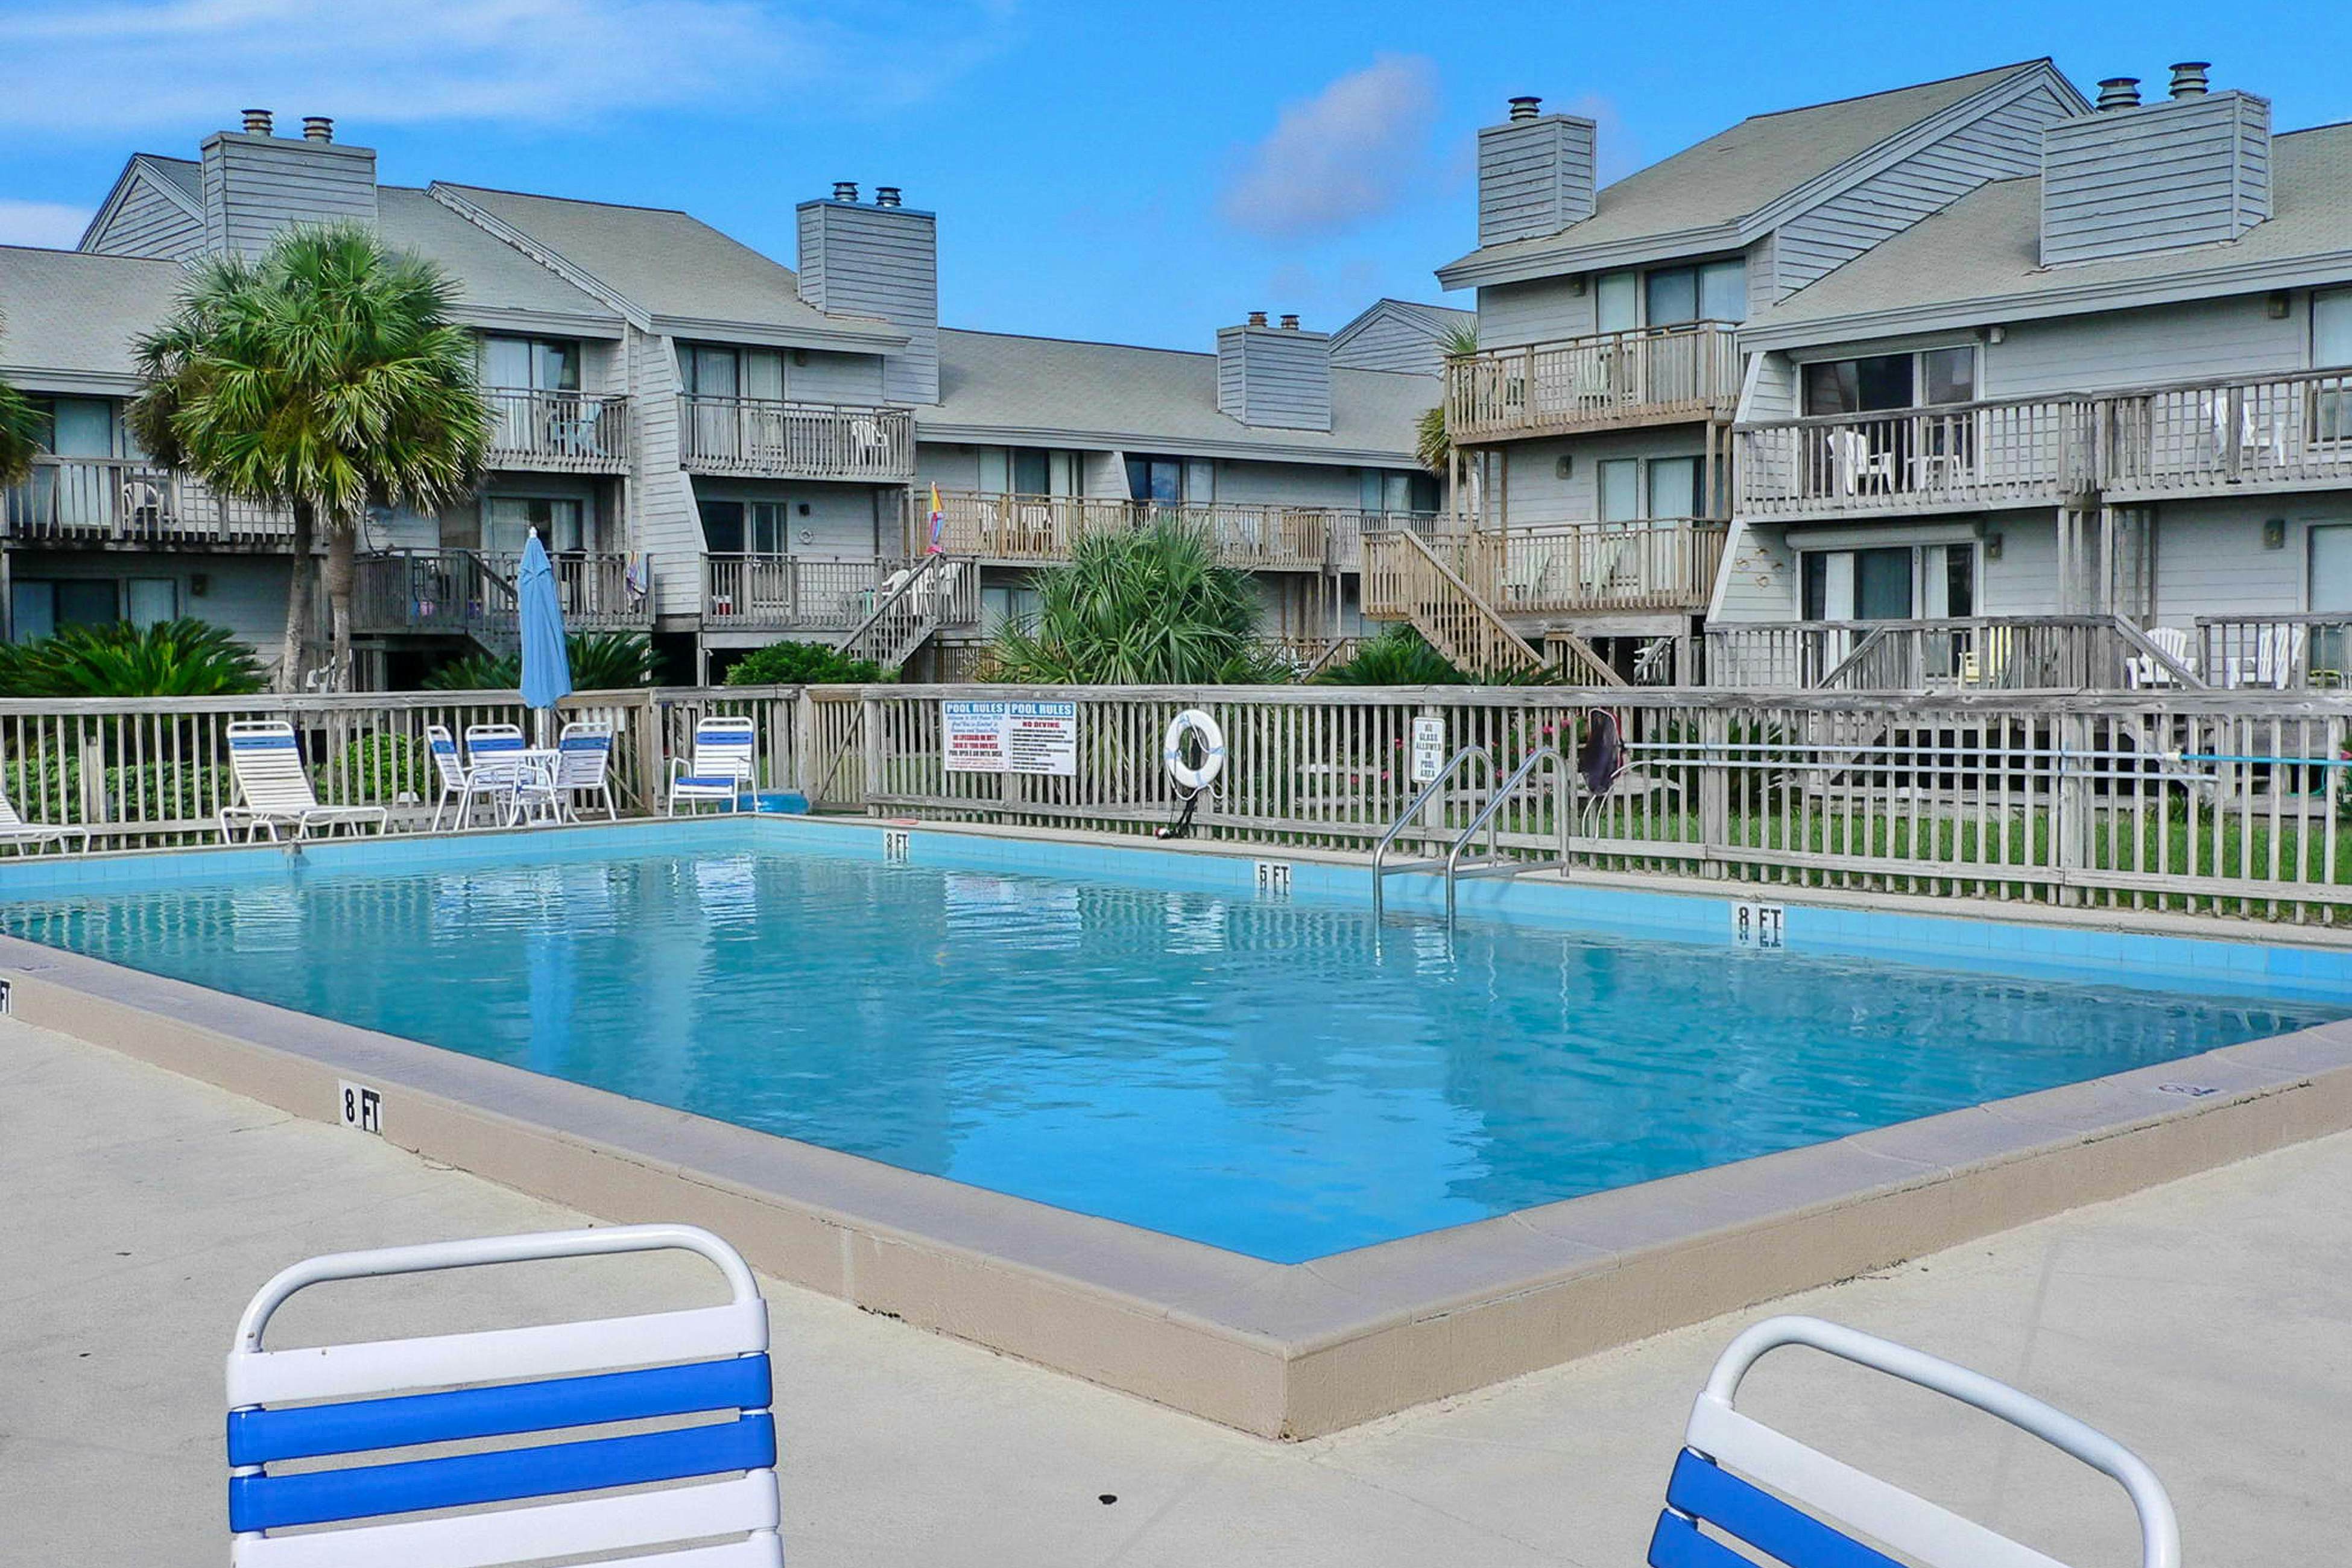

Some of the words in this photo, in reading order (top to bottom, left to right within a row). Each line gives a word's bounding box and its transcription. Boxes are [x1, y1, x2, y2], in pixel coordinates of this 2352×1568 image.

[946, 703, 971, 713] POOL
[973, 703, 1004, 713] RULES
[1011, 703, 1037, 714] POOL
[1039, 704, 1072, 715] RULES
[1259, 864, 1267, 882] 5
[1739, 906, 1748, 927] 8
[346, 1088, 355, 1122] 8
[362, 1088, 380, 1132] FT
